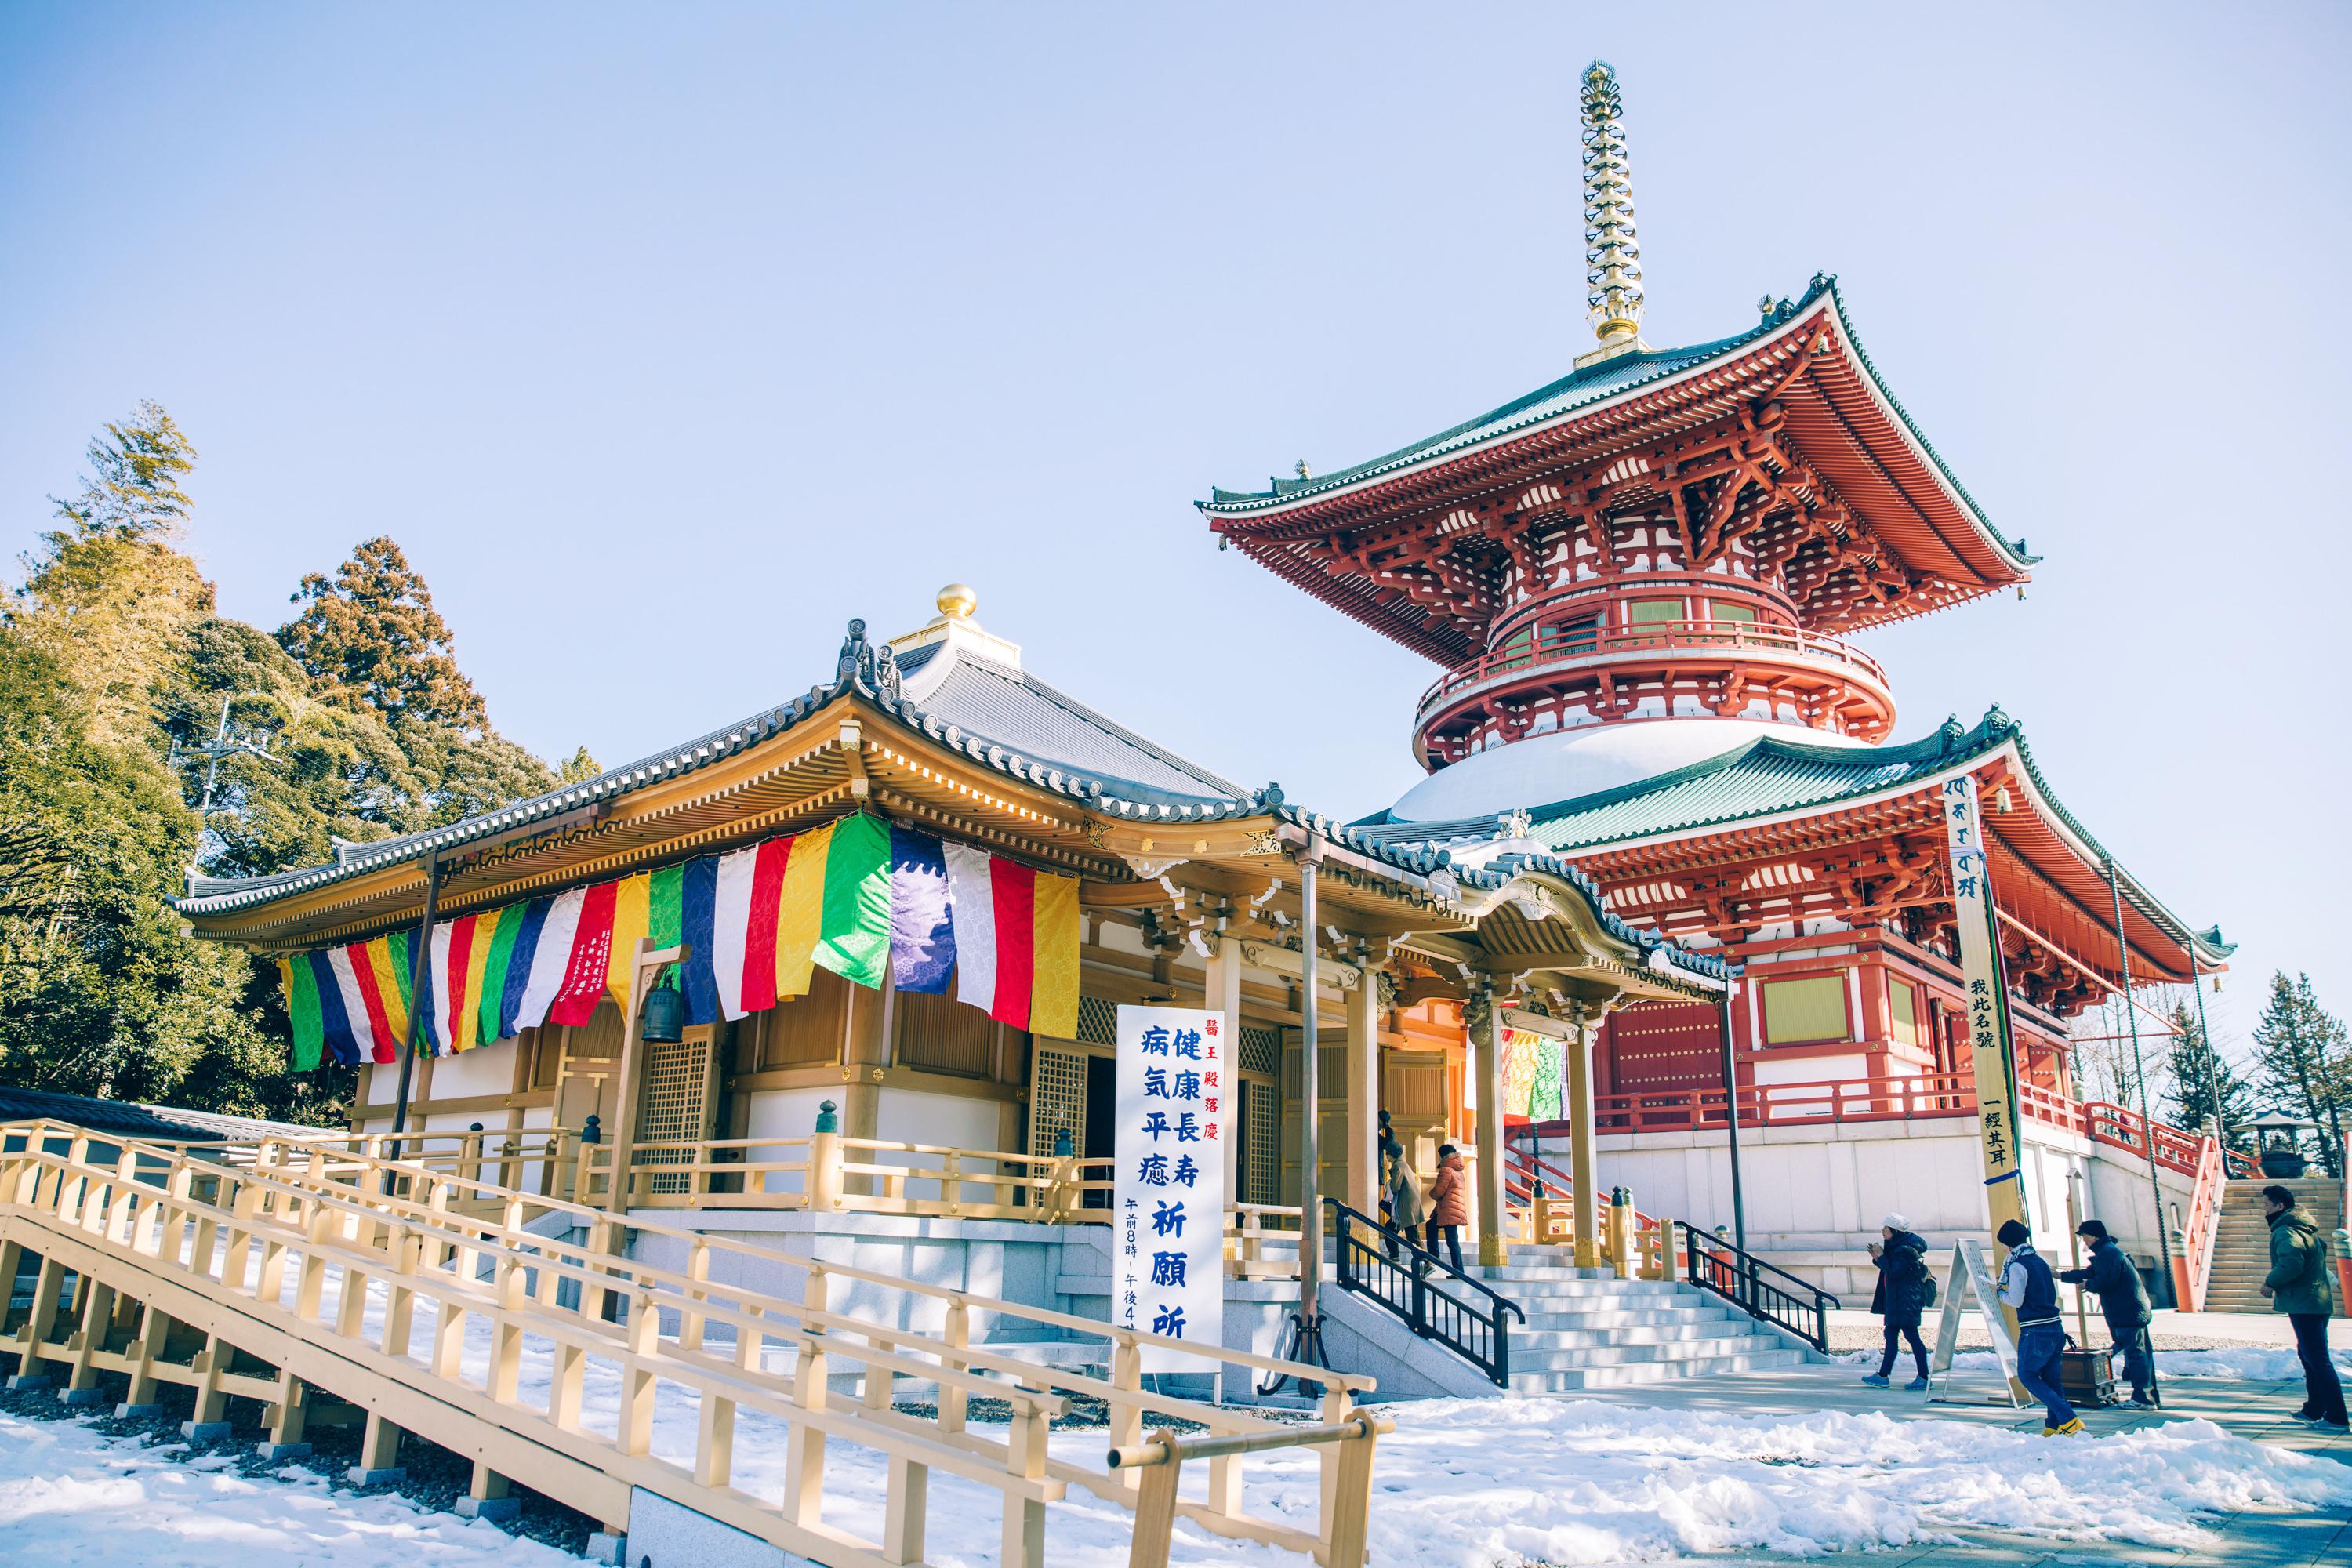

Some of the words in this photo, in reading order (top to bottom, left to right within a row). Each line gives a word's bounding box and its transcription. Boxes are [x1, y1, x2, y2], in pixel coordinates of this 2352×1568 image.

[1203, 1019, 1219, 1141] 醫王殿落慶
[1970, 979, 1996, 1048] 我此名號
[1138, 1025, 1171, 1187] 病気平癒
[1171, 1028, 1203, 1188] 健康長寿
[1150, 1200, 1188, 1339] 祈願所
